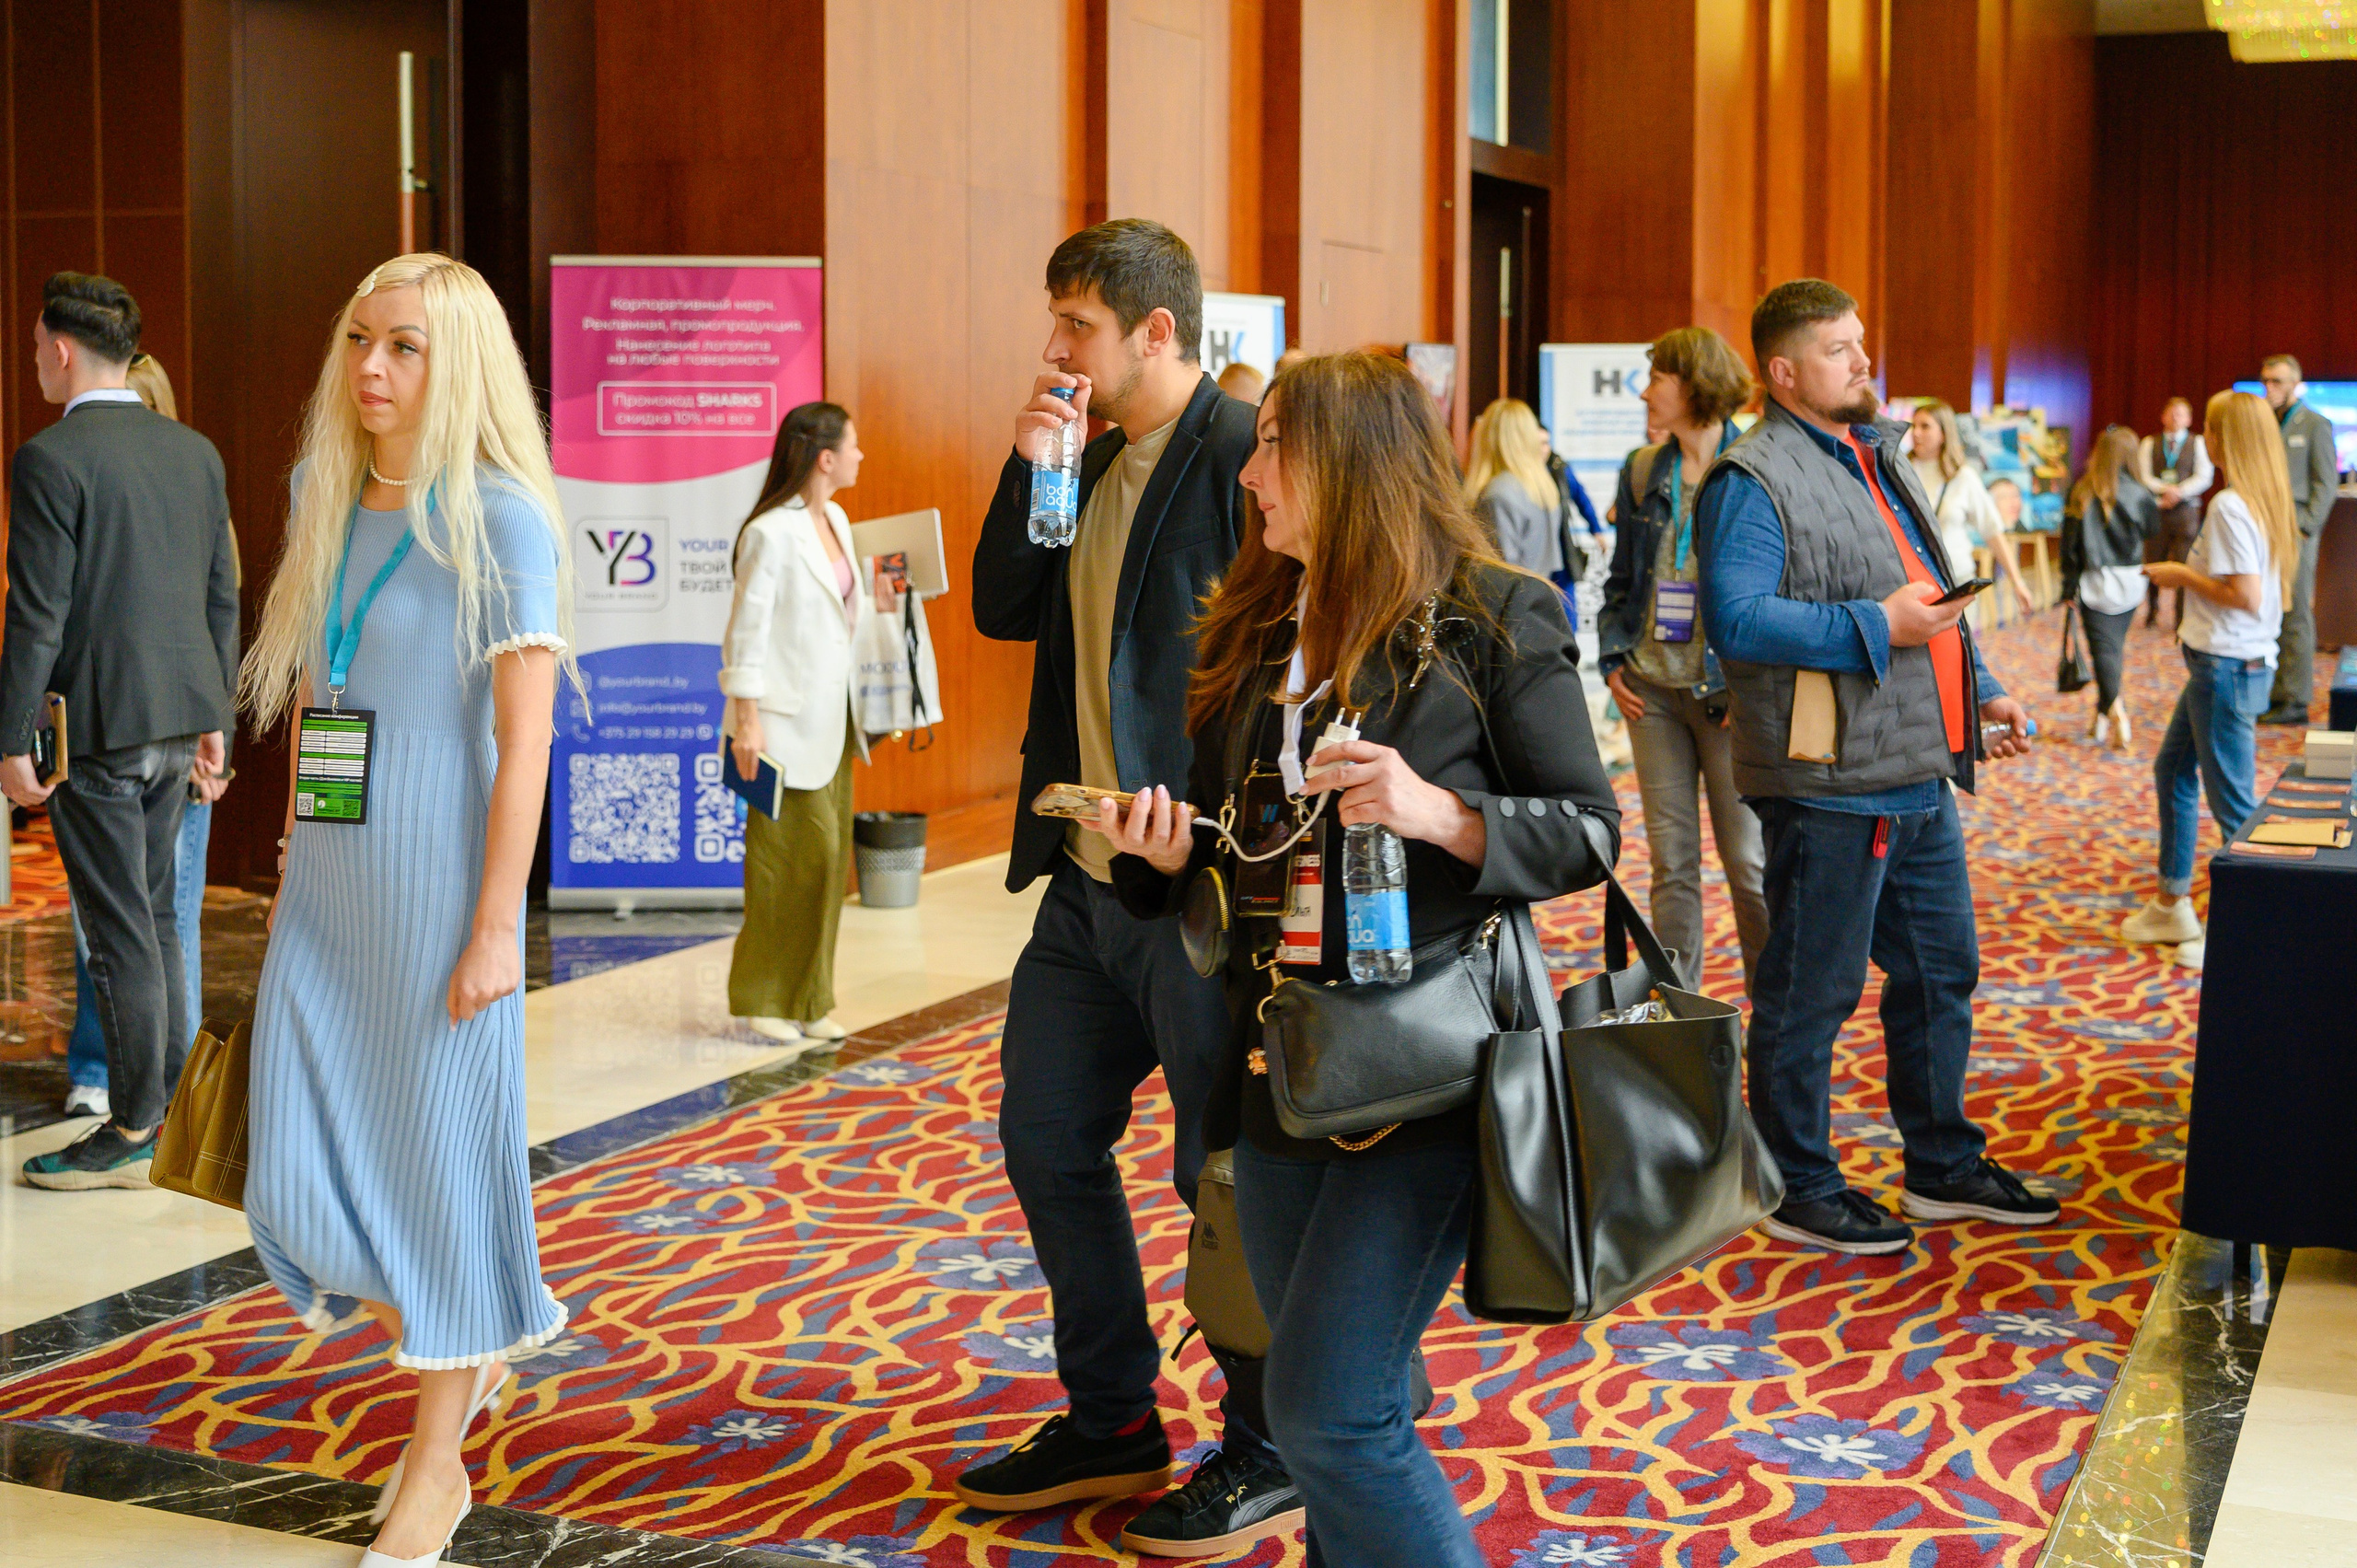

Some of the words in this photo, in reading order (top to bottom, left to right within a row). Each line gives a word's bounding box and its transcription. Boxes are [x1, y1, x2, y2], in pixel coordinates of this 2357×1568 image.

[610, 299, 732, 314] Корпоративный
[582, 317, 669, 332] Рекламная,
[616, 337, 701, 352] Нанесение
[702, 340, 772, 352] логотипа
[607, 354, 627, 366] на
[628, 353, 680, 366] любые
[682, 354, 780, 367] поверхности
[612, 391, 695, 409] Промокод
[696, 392, 763, 408] SHARKS
[614, 412, 671, 425] скидка
[673, 411, 703, 424] 10%
[704, 412, 726, 424] на
[679, 539, 728, 552] YOUR
[679, 557, 726, 575] ТВОЙ
[679, 579, 735, 593] БУДЕТ
